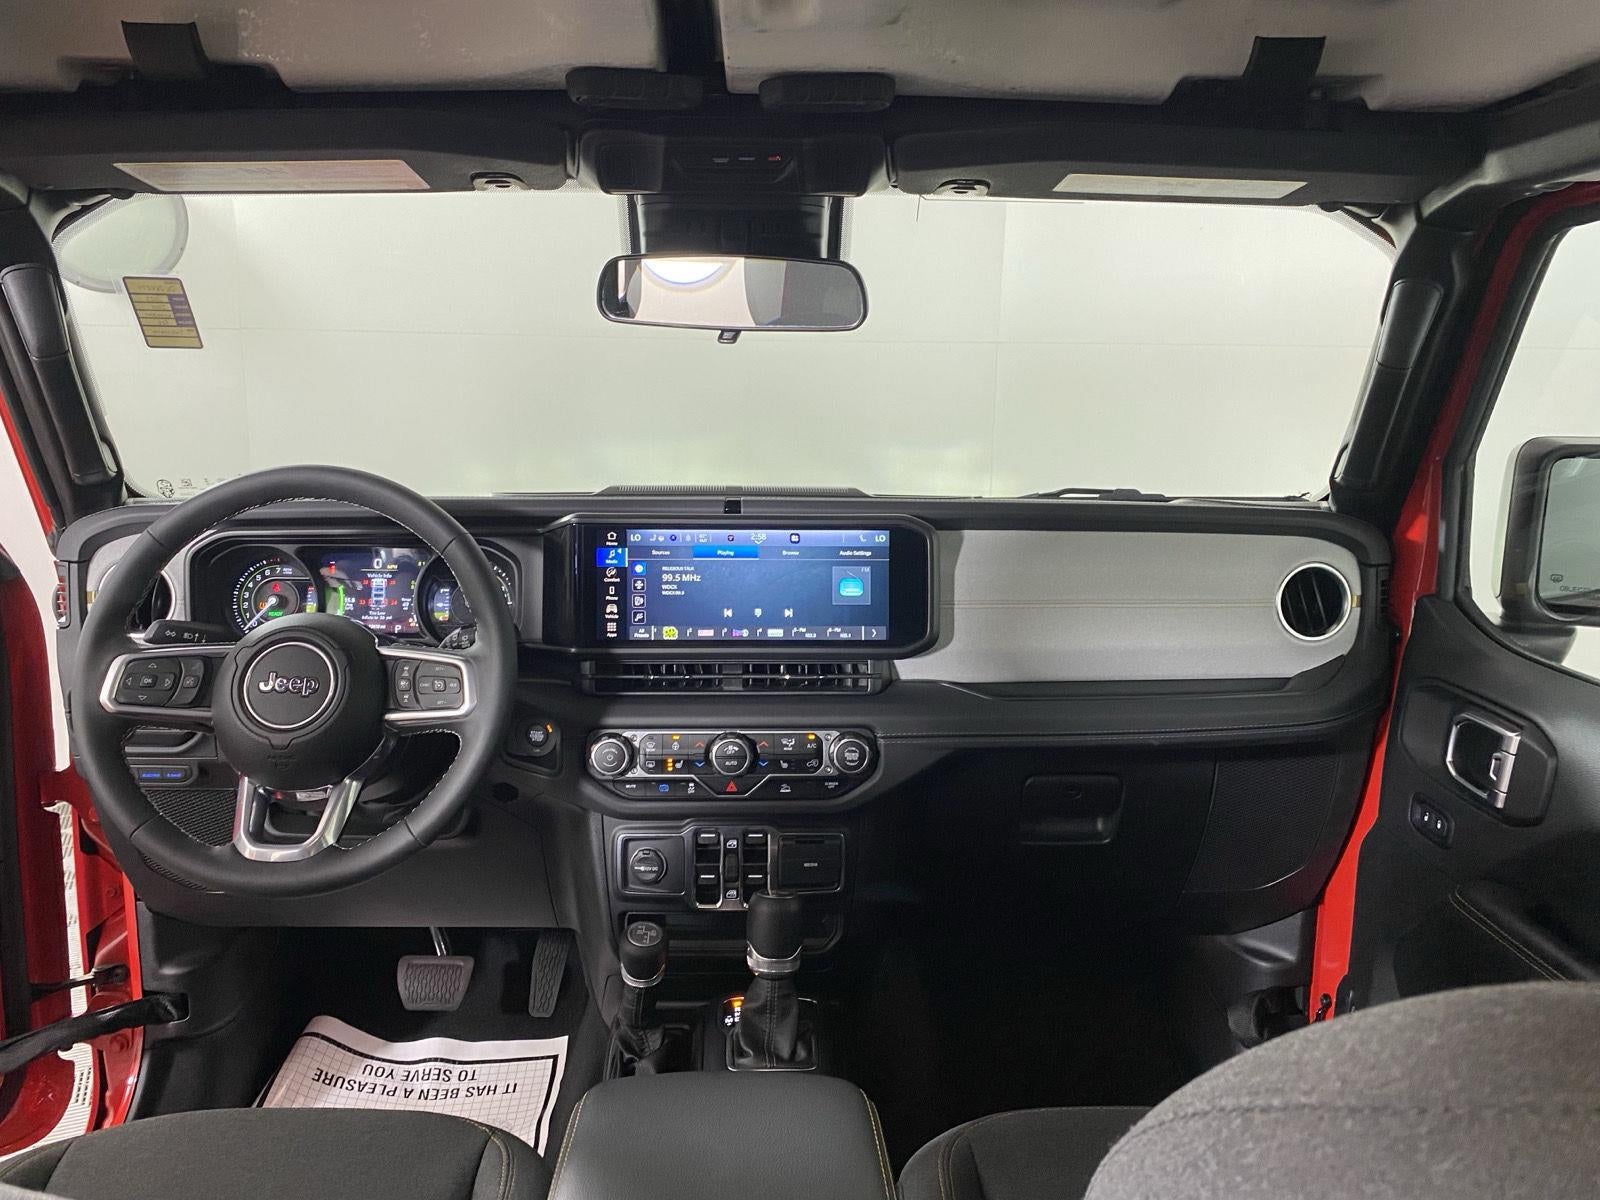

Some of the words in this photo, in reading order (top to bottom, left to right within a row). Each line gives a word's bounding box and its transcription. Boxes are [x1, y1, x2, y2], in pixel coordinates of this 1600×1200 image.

[875, 534, 886, 542] LO
[662, 573, 681, 582] 99.5
[682, 573, 701, 582] MHz
[259, 672, 319, 696] Jeep
[361, 1063, 395, 1080] YOU
[400, 1067, 453, 1082] SERVE
[457, 1069, 478, 1082] TO
[311, 1067, 398, 1097] PLEASURE
[501, 1082, 517, 1094] IT
[403, 1087, 414, 1099] A
[417, 1087, 459, 1101] BEEN
[465, 1083, 497, 1098] HAS
